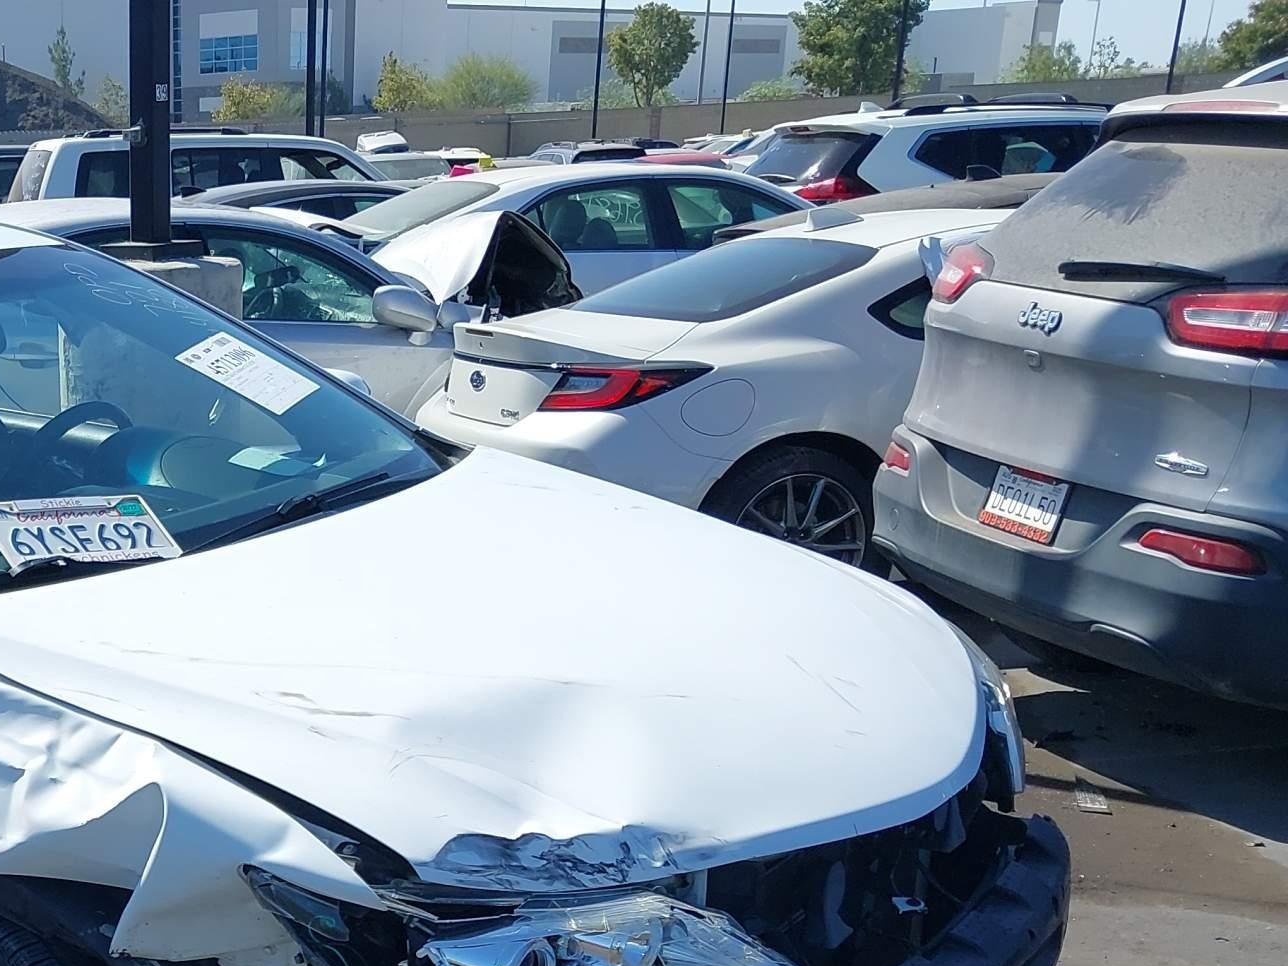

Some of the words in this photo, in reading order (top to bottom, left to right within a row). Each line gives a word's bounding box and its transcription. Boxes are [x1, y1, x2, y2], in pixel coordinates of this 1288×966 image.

[1018, 301, 1063, 337] Jeep
[40, 499, 82, 508] Stickie
[11, 521, 170, 557] 6YSE692
